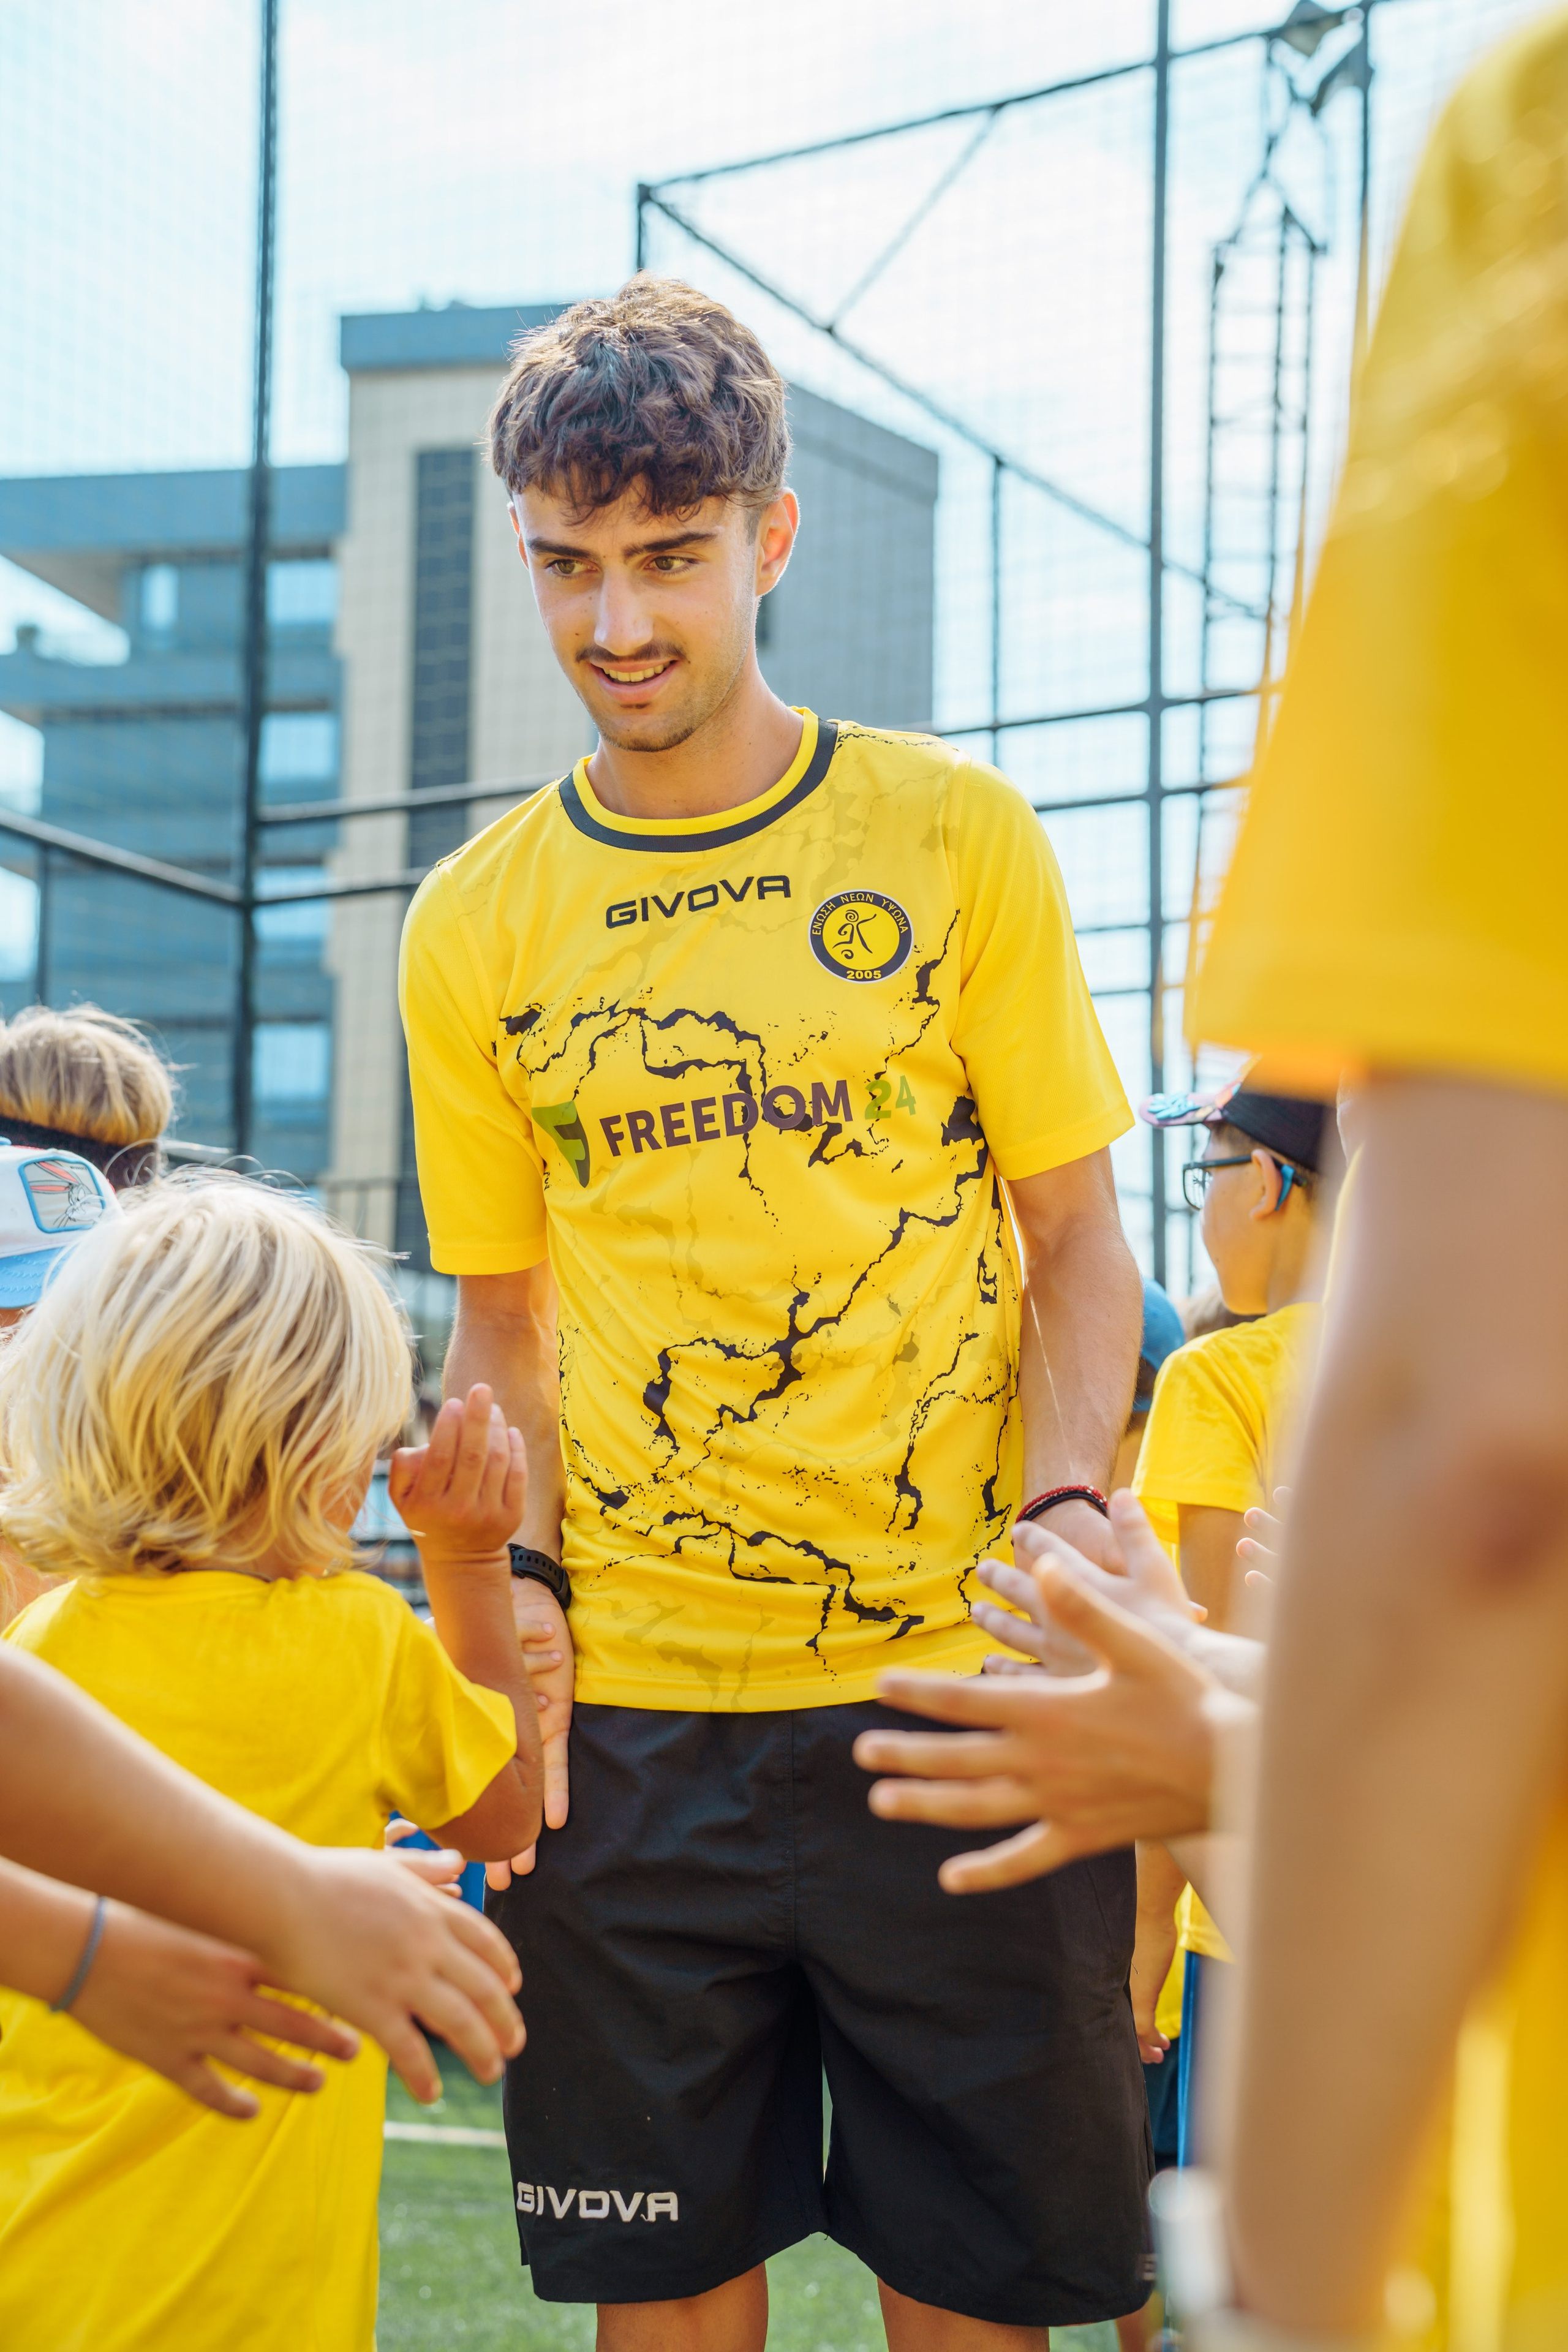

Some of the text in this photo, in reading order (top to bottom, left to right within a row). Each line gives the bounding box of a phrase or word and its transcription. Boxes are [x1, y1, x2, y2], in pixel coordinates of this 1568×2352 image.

[606, 875, 791, 929] GIVOVA
[812, 892, 908, 935] ΕΝΩΣΗ ΝΕΩΝ ΥΨΩΝΑ
[846, 970, 881, 979] 2005
[599, 1075, 916, 1157] FREEDOM 24
[516, 2181, 679, 2222] GIVOVA
